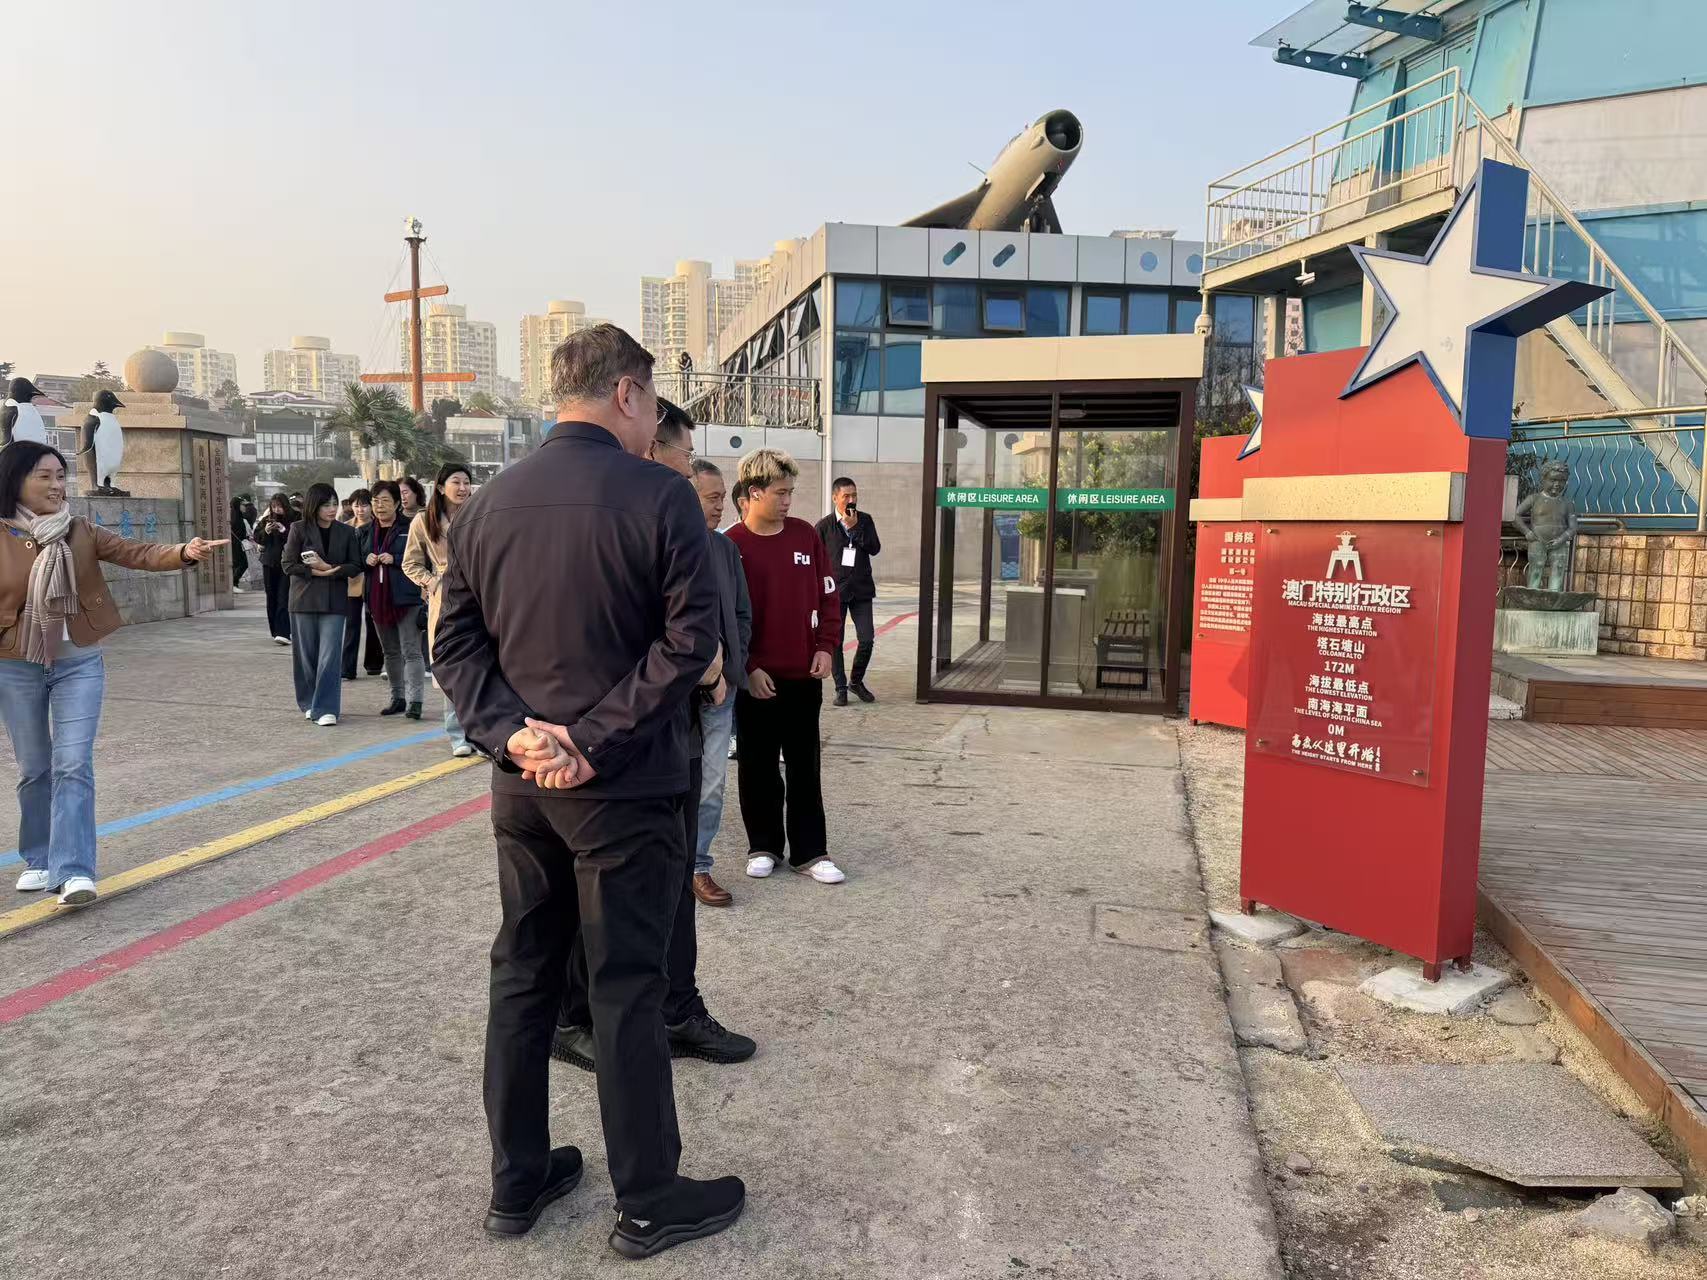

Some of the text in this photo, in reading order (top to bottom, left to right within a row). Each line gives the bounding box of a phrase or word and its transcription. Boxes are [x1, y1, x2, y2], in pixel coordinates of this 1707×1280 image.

[947, 491, 1039, 503] 休闲区 LEISURE AREA
[1067, 493, 1165, 505] 休闲区 LEISURE AREA
[793, 551, 811, 565] Fu
[823, 576, 836, 594] D
[1282, 579, 1411, 608] 澳门特别行政区
[1307, 601, 1331, 609] SPECIAL
[1377, 606, 1401, 614] REGION
[1312, 612, 1373, 630] 海拔最高点
[1318, 626, 1344, 634] HIGHEST
[1344, 628, 1378, 637] ELEVATION
[1316, 636, 1365, 654] 塔石塘山
[1318, 650, 1362, 660] COLOANE ALTO
[1324, 661, 1355, 674] 172M
[1309, 674, 1369, 695] 海拔最低点
[1316, 687, 1340, 696] LOWEST
[1340, 691, 1373, 701] ELEVATION
[1307, 697, 1368, 718] 南海海平面
[1304, 709, 1321, 717] LEVEL
[1322, 711, 1330, 719] OF
[1330, 713, 1351, 722] SOUTH
[1351, 716, 1370, 726] CHINA
[1370, 719, 1382, 727] SEA
[1327, 724, 1345, 736] 0M
[1320, 754, 1340, 763] STARTS
[1340, 758, 1357, 767] FROM
[1357, 761, 1373, 770] HERE
